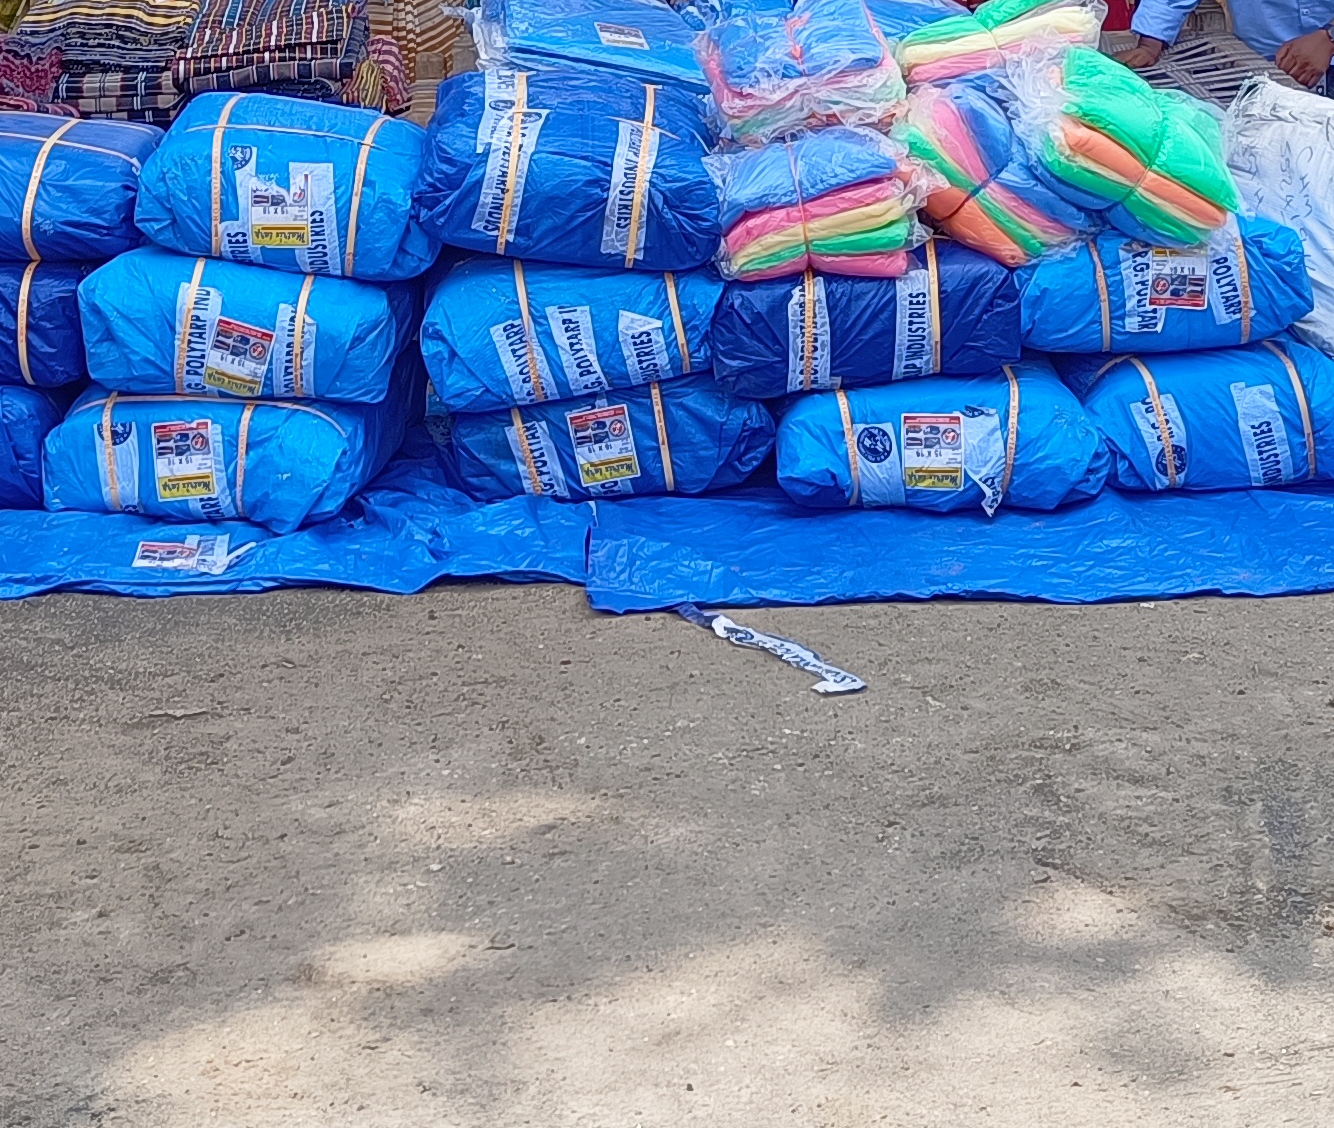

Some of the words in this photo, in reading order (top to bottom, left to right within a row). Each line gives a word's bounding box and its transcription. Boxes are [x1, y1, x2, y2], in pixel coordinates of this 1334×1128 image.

[1212, 256, 1242, 316] POLYTARP
[186, 314, 208, 376] POLYTARP
[904, 292, 927, 360] INDUSTRIES
